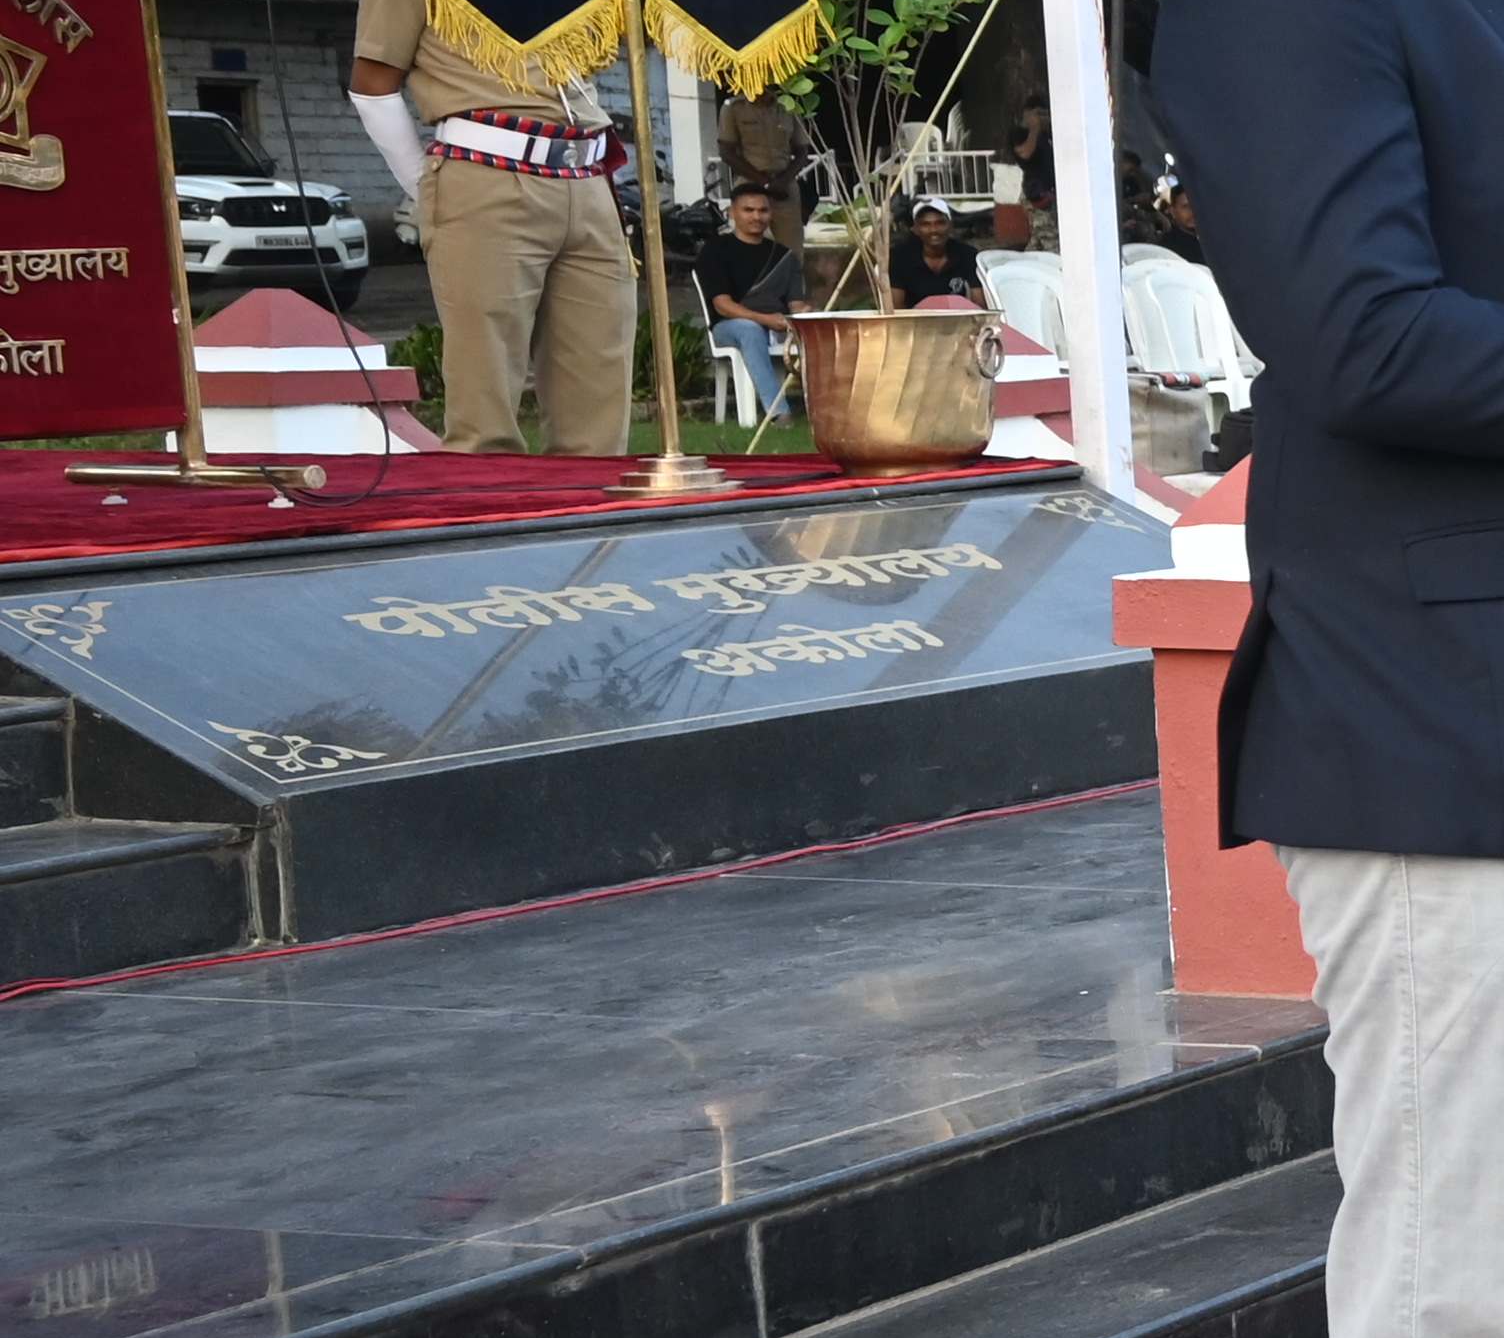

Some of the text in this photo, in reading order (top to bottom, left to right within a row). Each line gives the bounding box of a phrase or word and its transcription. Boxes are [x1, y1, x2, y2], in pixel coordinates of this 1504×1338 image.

[343, 543, 1003, 638] पोलीस मुख्यालय
[681, 619, 945, 677] अकोला
